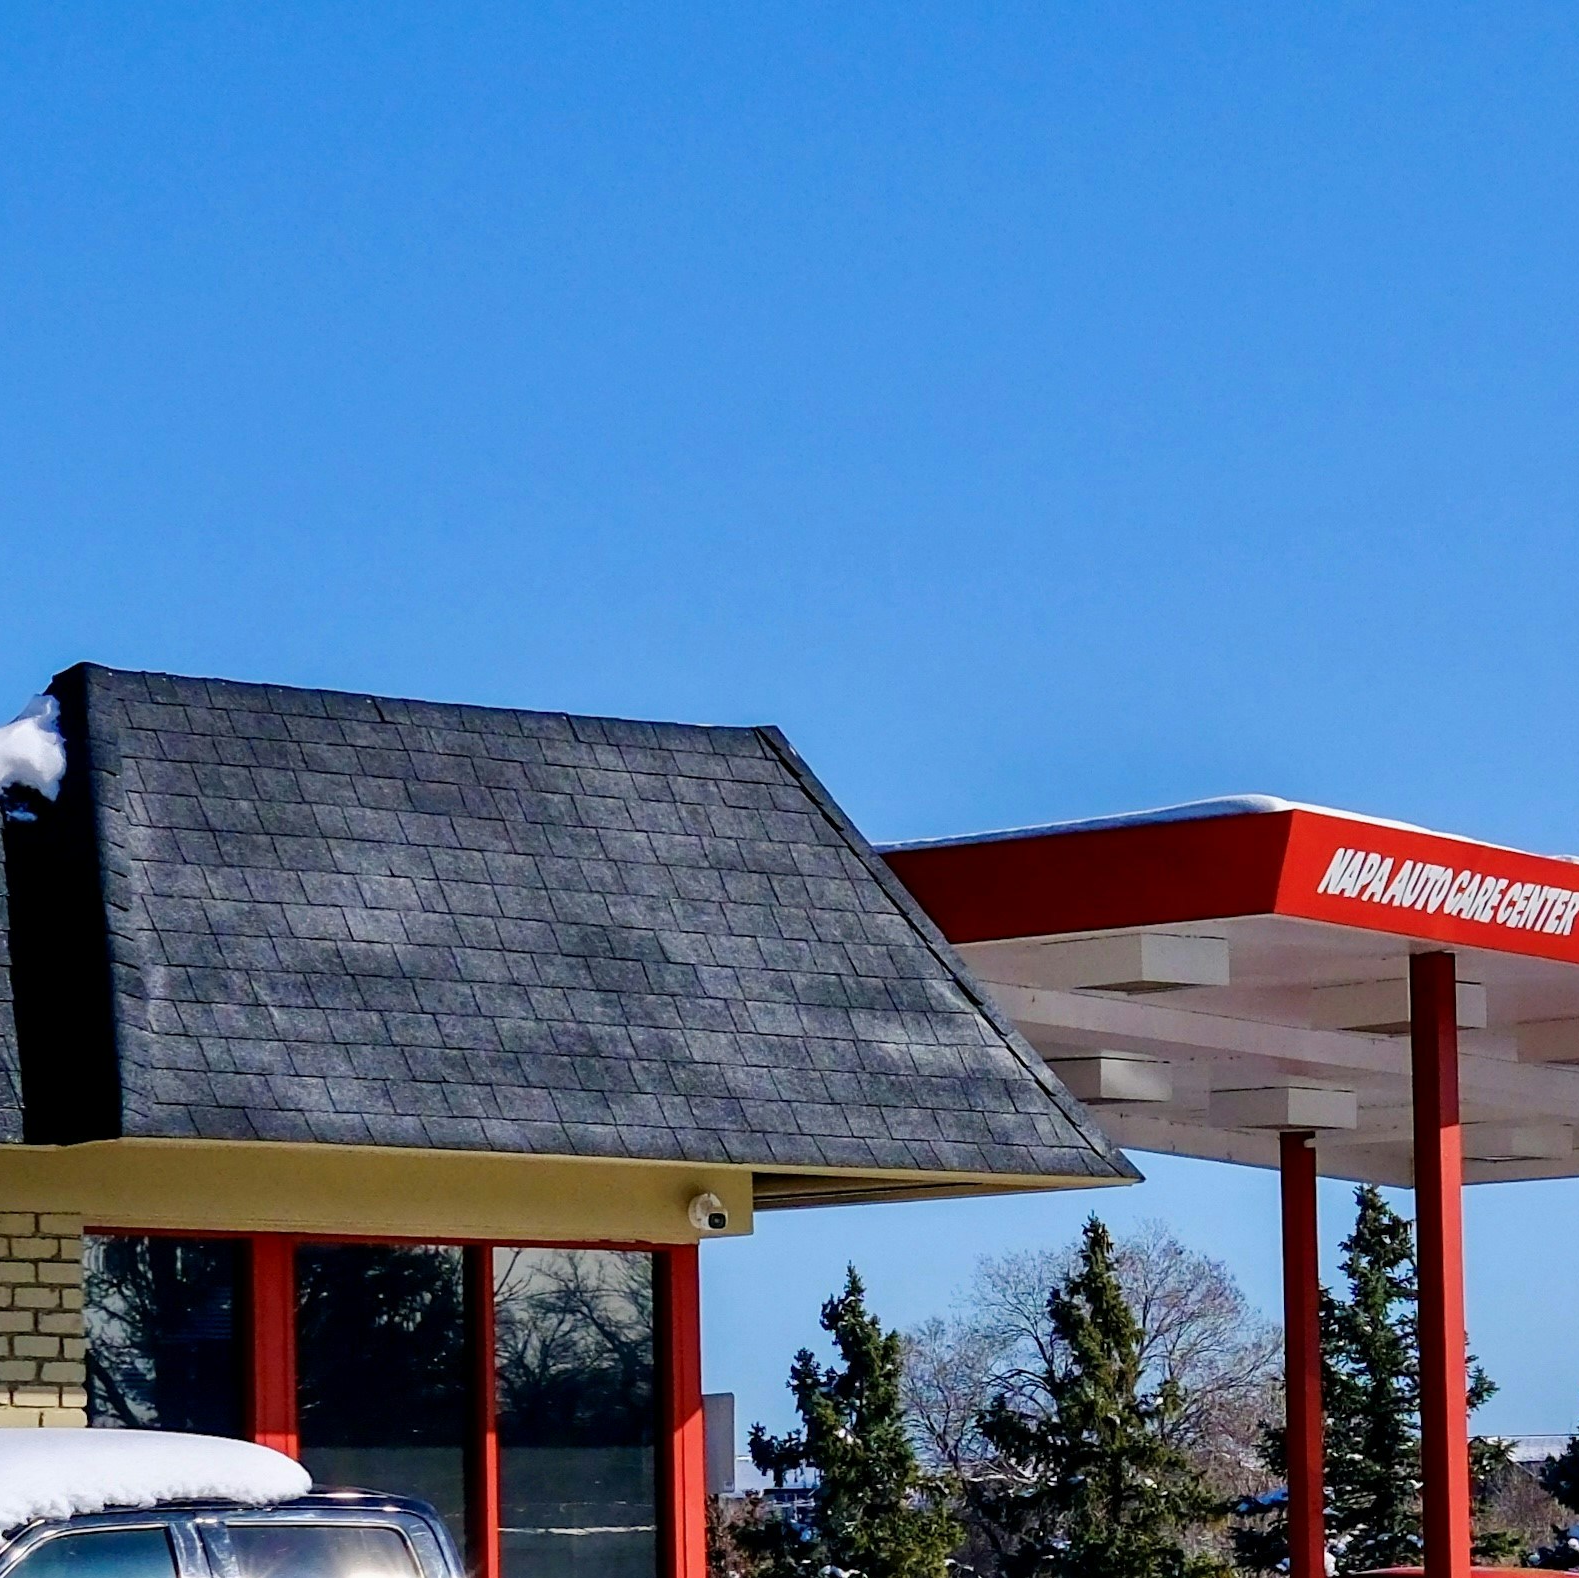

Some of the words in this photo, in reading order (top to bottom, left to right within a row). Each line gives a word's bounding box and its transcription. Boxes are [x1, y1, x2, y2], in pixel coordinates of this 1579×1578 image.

[1317, 847, 1395, 902] NAPA
[1380, 859, 1454, 914] AUTO
[1443, 869, 1510, 923] CARE
